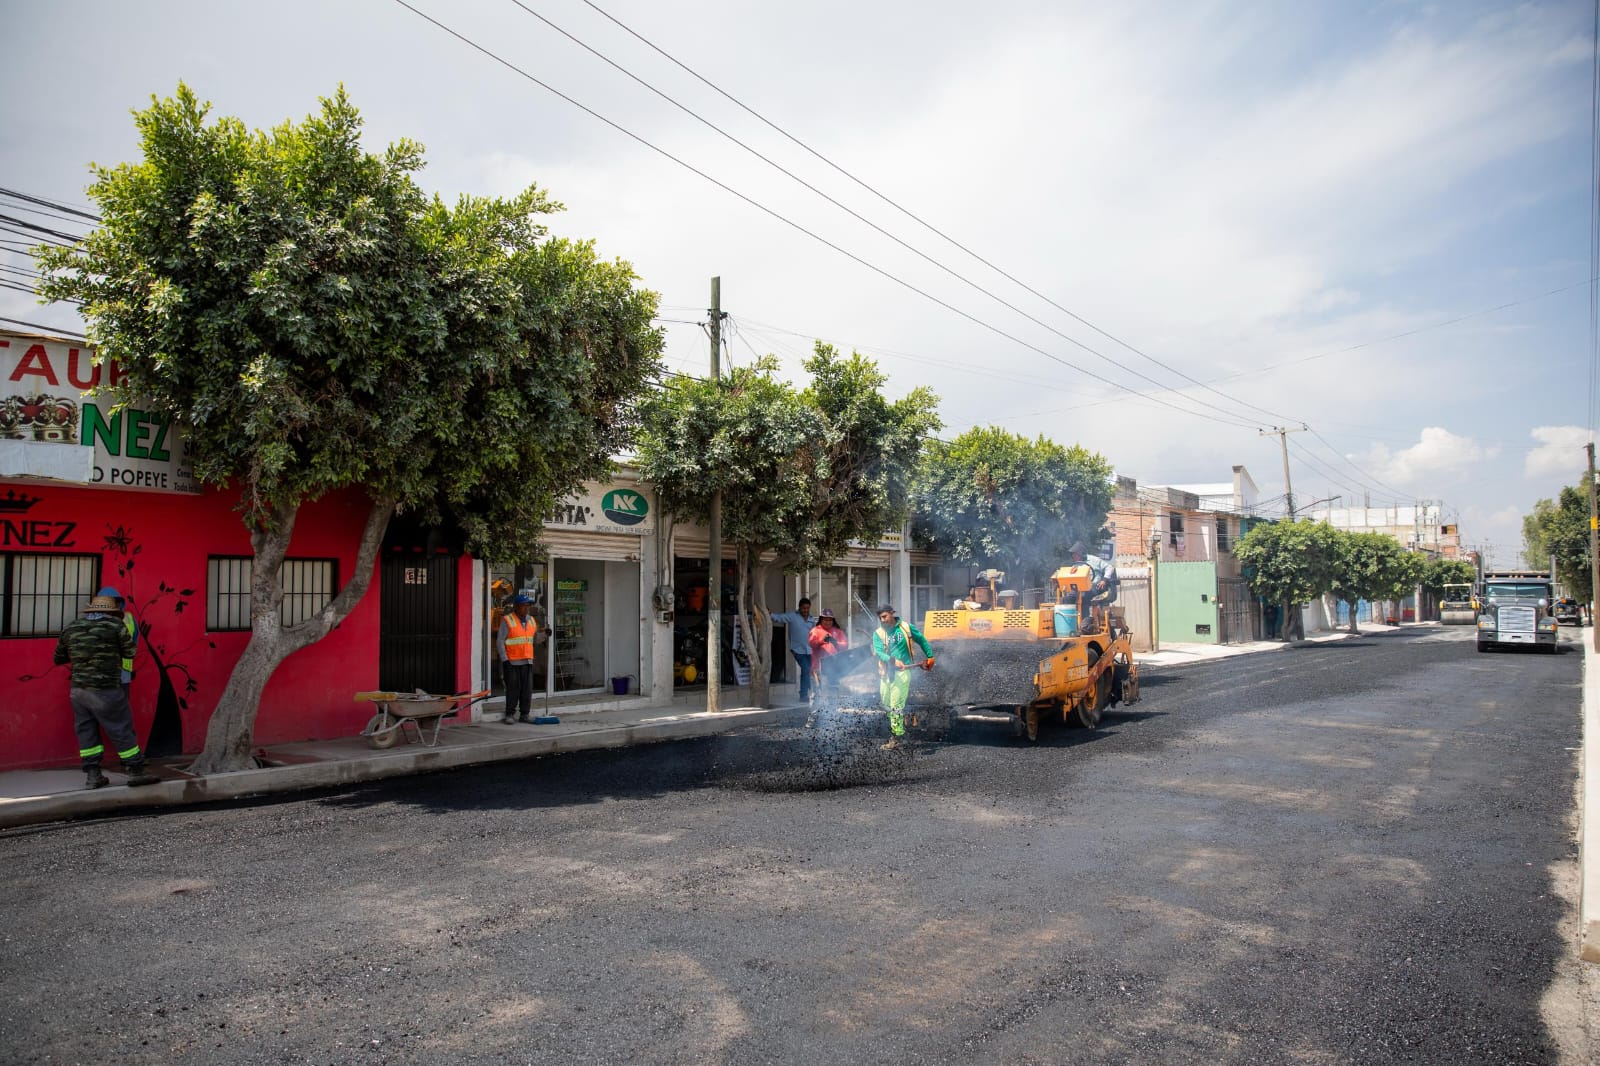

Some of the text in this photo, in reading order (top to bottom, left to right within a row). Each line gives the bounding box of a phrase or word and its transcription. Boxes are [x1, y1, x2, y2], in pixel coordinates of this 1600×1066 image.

[111, 468, 168, 488] POPEYE
[613, 494, 638, 511] NK
[0, 519, 77, 547] NEZ
